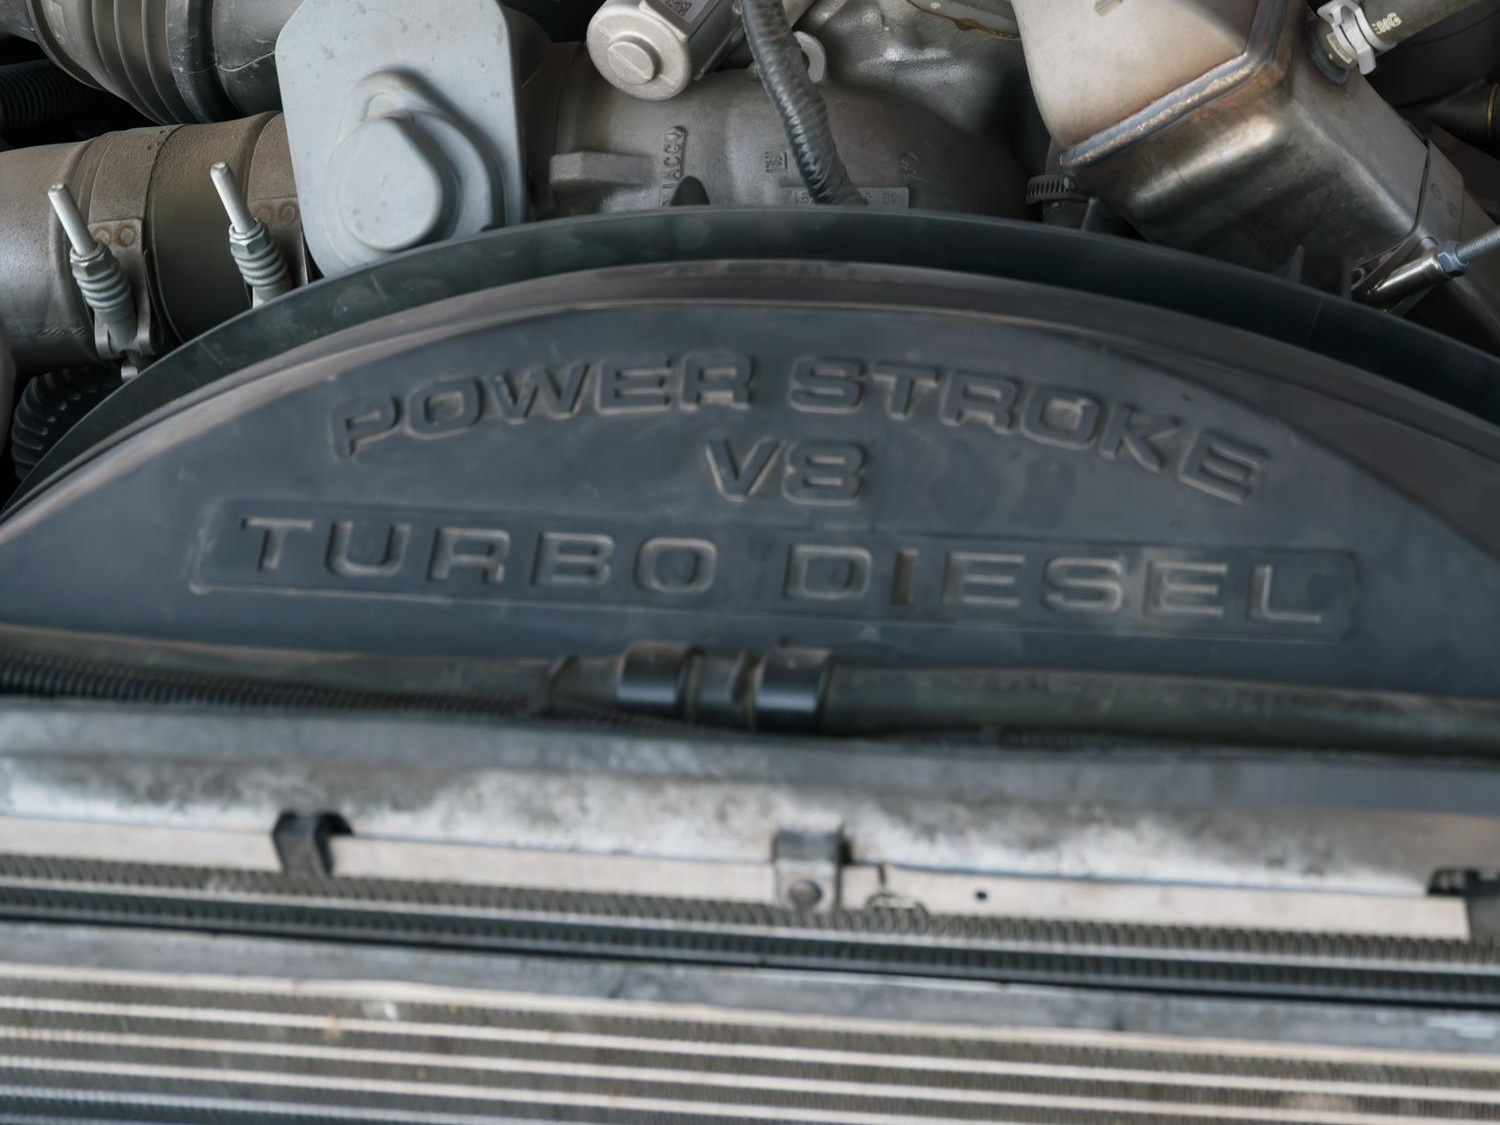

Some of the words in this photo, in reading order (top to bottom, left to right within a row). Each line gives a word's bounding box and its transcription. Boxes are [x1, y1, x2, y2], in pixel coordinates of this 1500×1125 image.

[332, 353, 758, 461] POWER
[787, 355, 1270, 506] STROKE
[704, 435, 870, 507] V8
[240, 515, 720, 595] TURBO
[782, 543, 1323, 625] DIESEL
